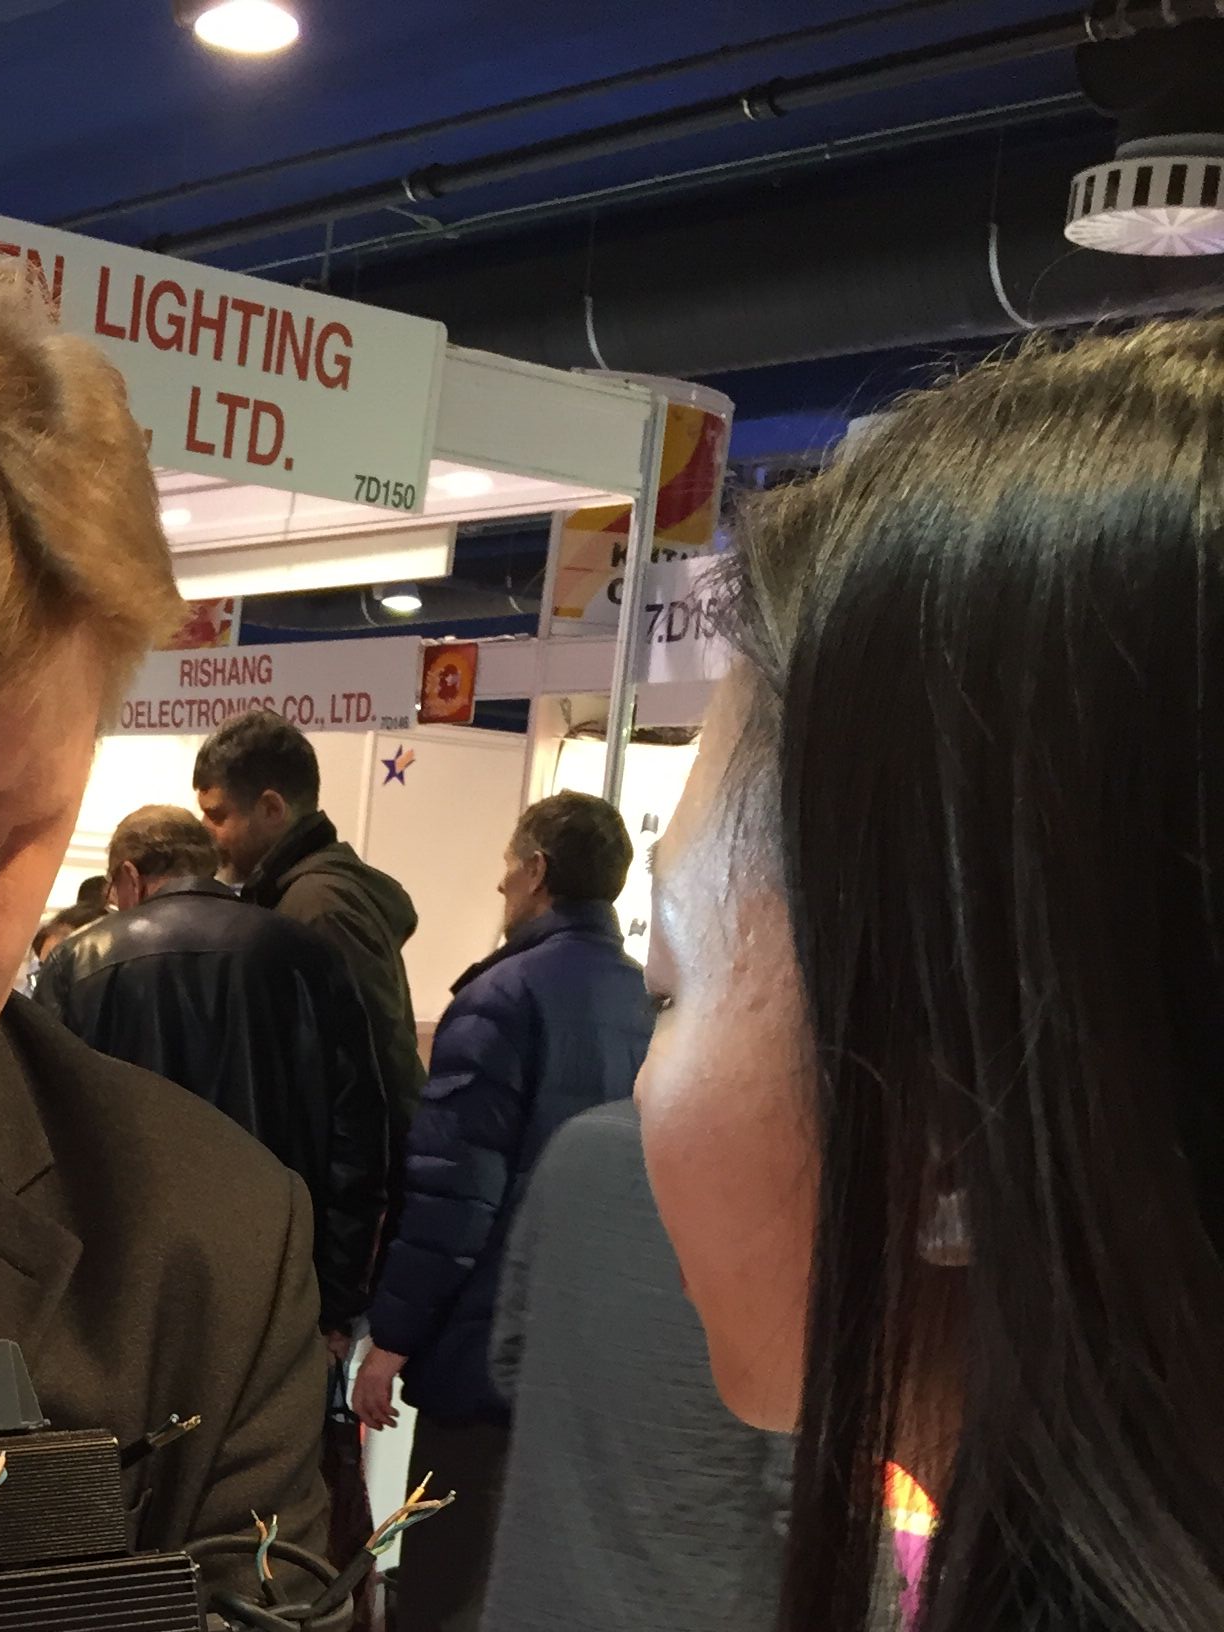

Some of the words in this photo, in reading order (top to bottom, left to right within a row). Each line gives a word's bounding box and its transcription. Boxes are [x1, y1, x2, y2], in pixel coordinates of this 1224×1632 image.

[95, 266, 353, 391] LIGHTING
[185, 386, 294, 471] LTD.
[354, 474, 416, 510] 7D150
[180, 654, 273, 687] RISHANG
[330, 692, 376, 724] LTD.
